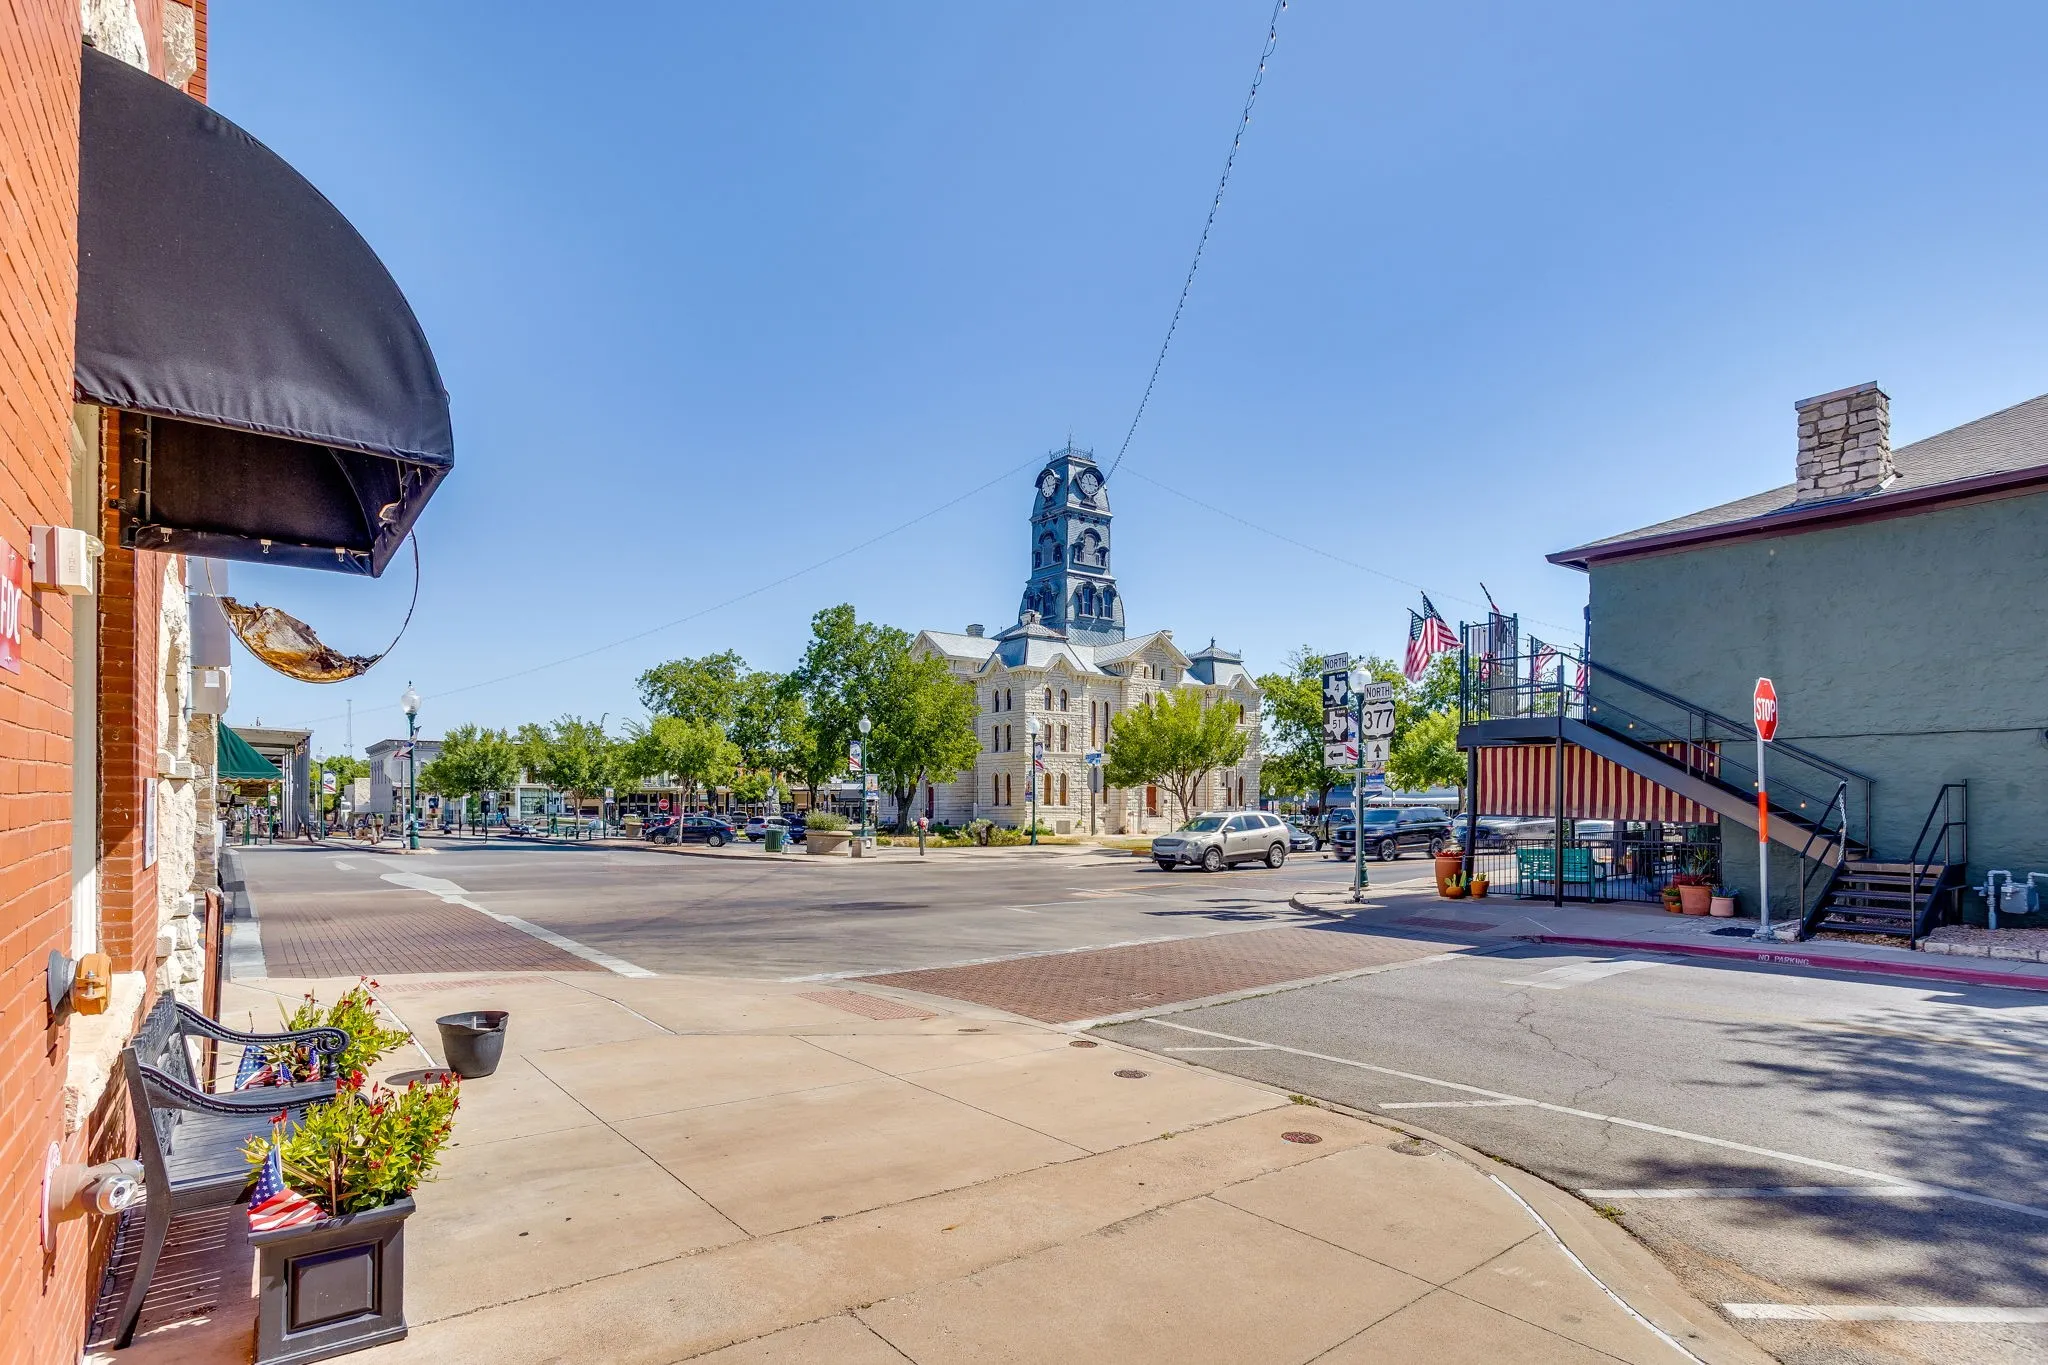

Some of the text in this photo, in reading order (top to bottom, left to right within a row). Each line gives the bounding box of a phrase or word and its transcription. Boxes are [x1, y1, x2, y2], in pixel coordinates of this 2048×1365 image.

[0, 574, 22, 645] FDC
[1324, 657, 1347, 670] NORTH
[1334, 683, 1340, 693] 4
[1366, 686, 1390, 698] NORTH
[1756, 697, 1776, 722] STOP
[1332, 719, 1341, 729] 51
[1363, 708, 1393, 730] 377
[1758, 954, 1809, 966] NO PARKING
